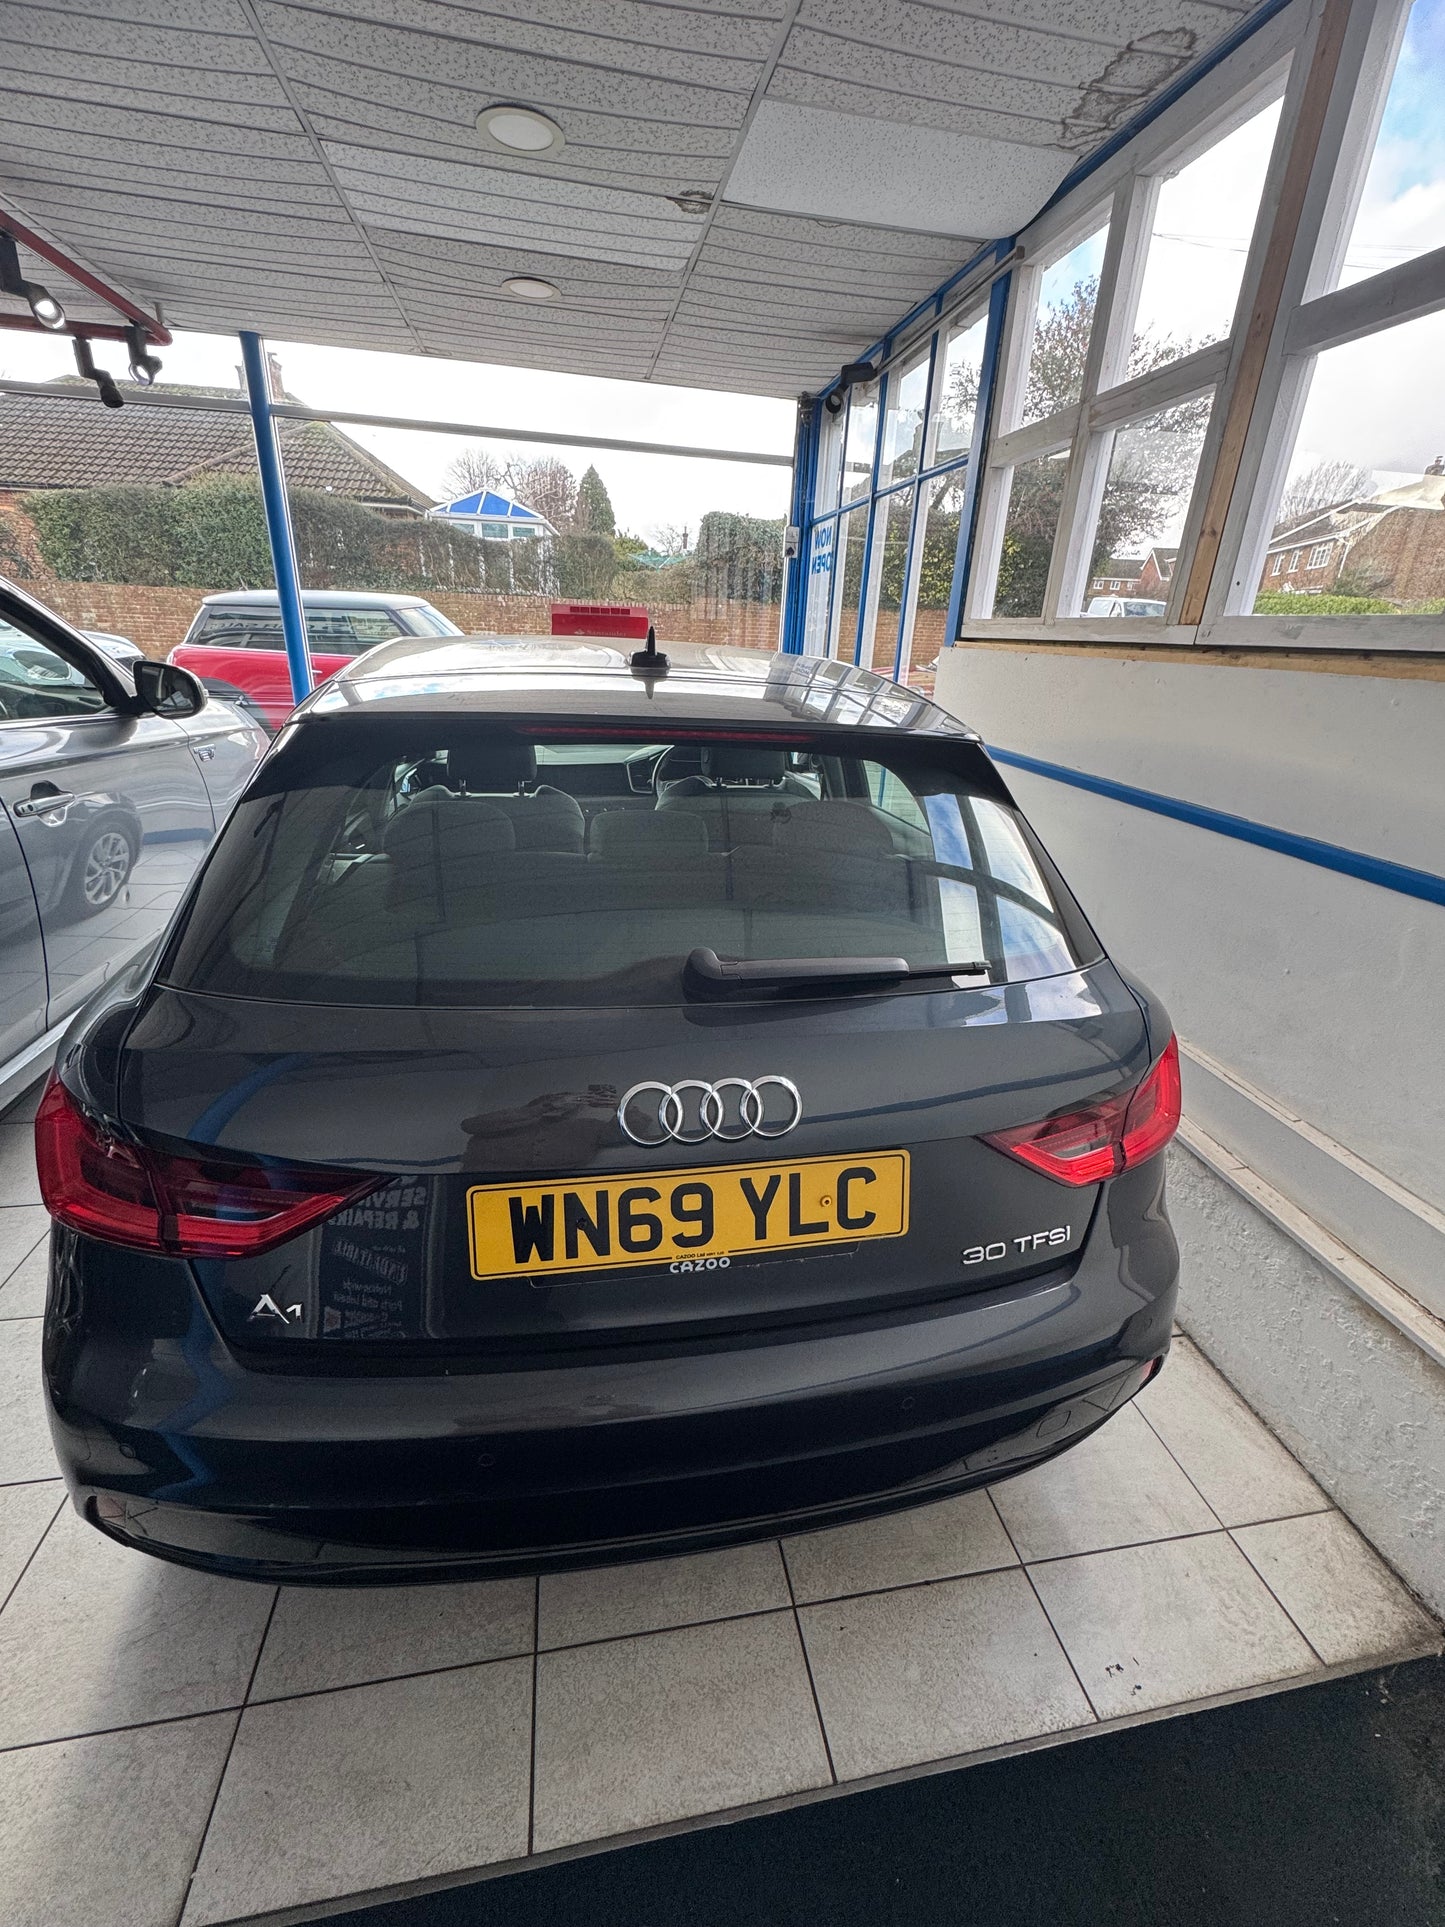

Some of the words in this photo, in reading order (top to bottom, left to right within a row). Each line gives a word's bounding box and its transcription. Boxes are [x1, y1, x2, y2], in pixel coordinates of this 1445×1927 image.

[509, 1182, 714, 1264] WN69
[740, 1166, 876, 1241] YLC
[963, 1242, 1006, 1265] 30
[1014, 1225, 1070, 1253] TFSI
[669, 1257, 731, 1273] CAZOO
[248, 1294, 302, 1324] A1
